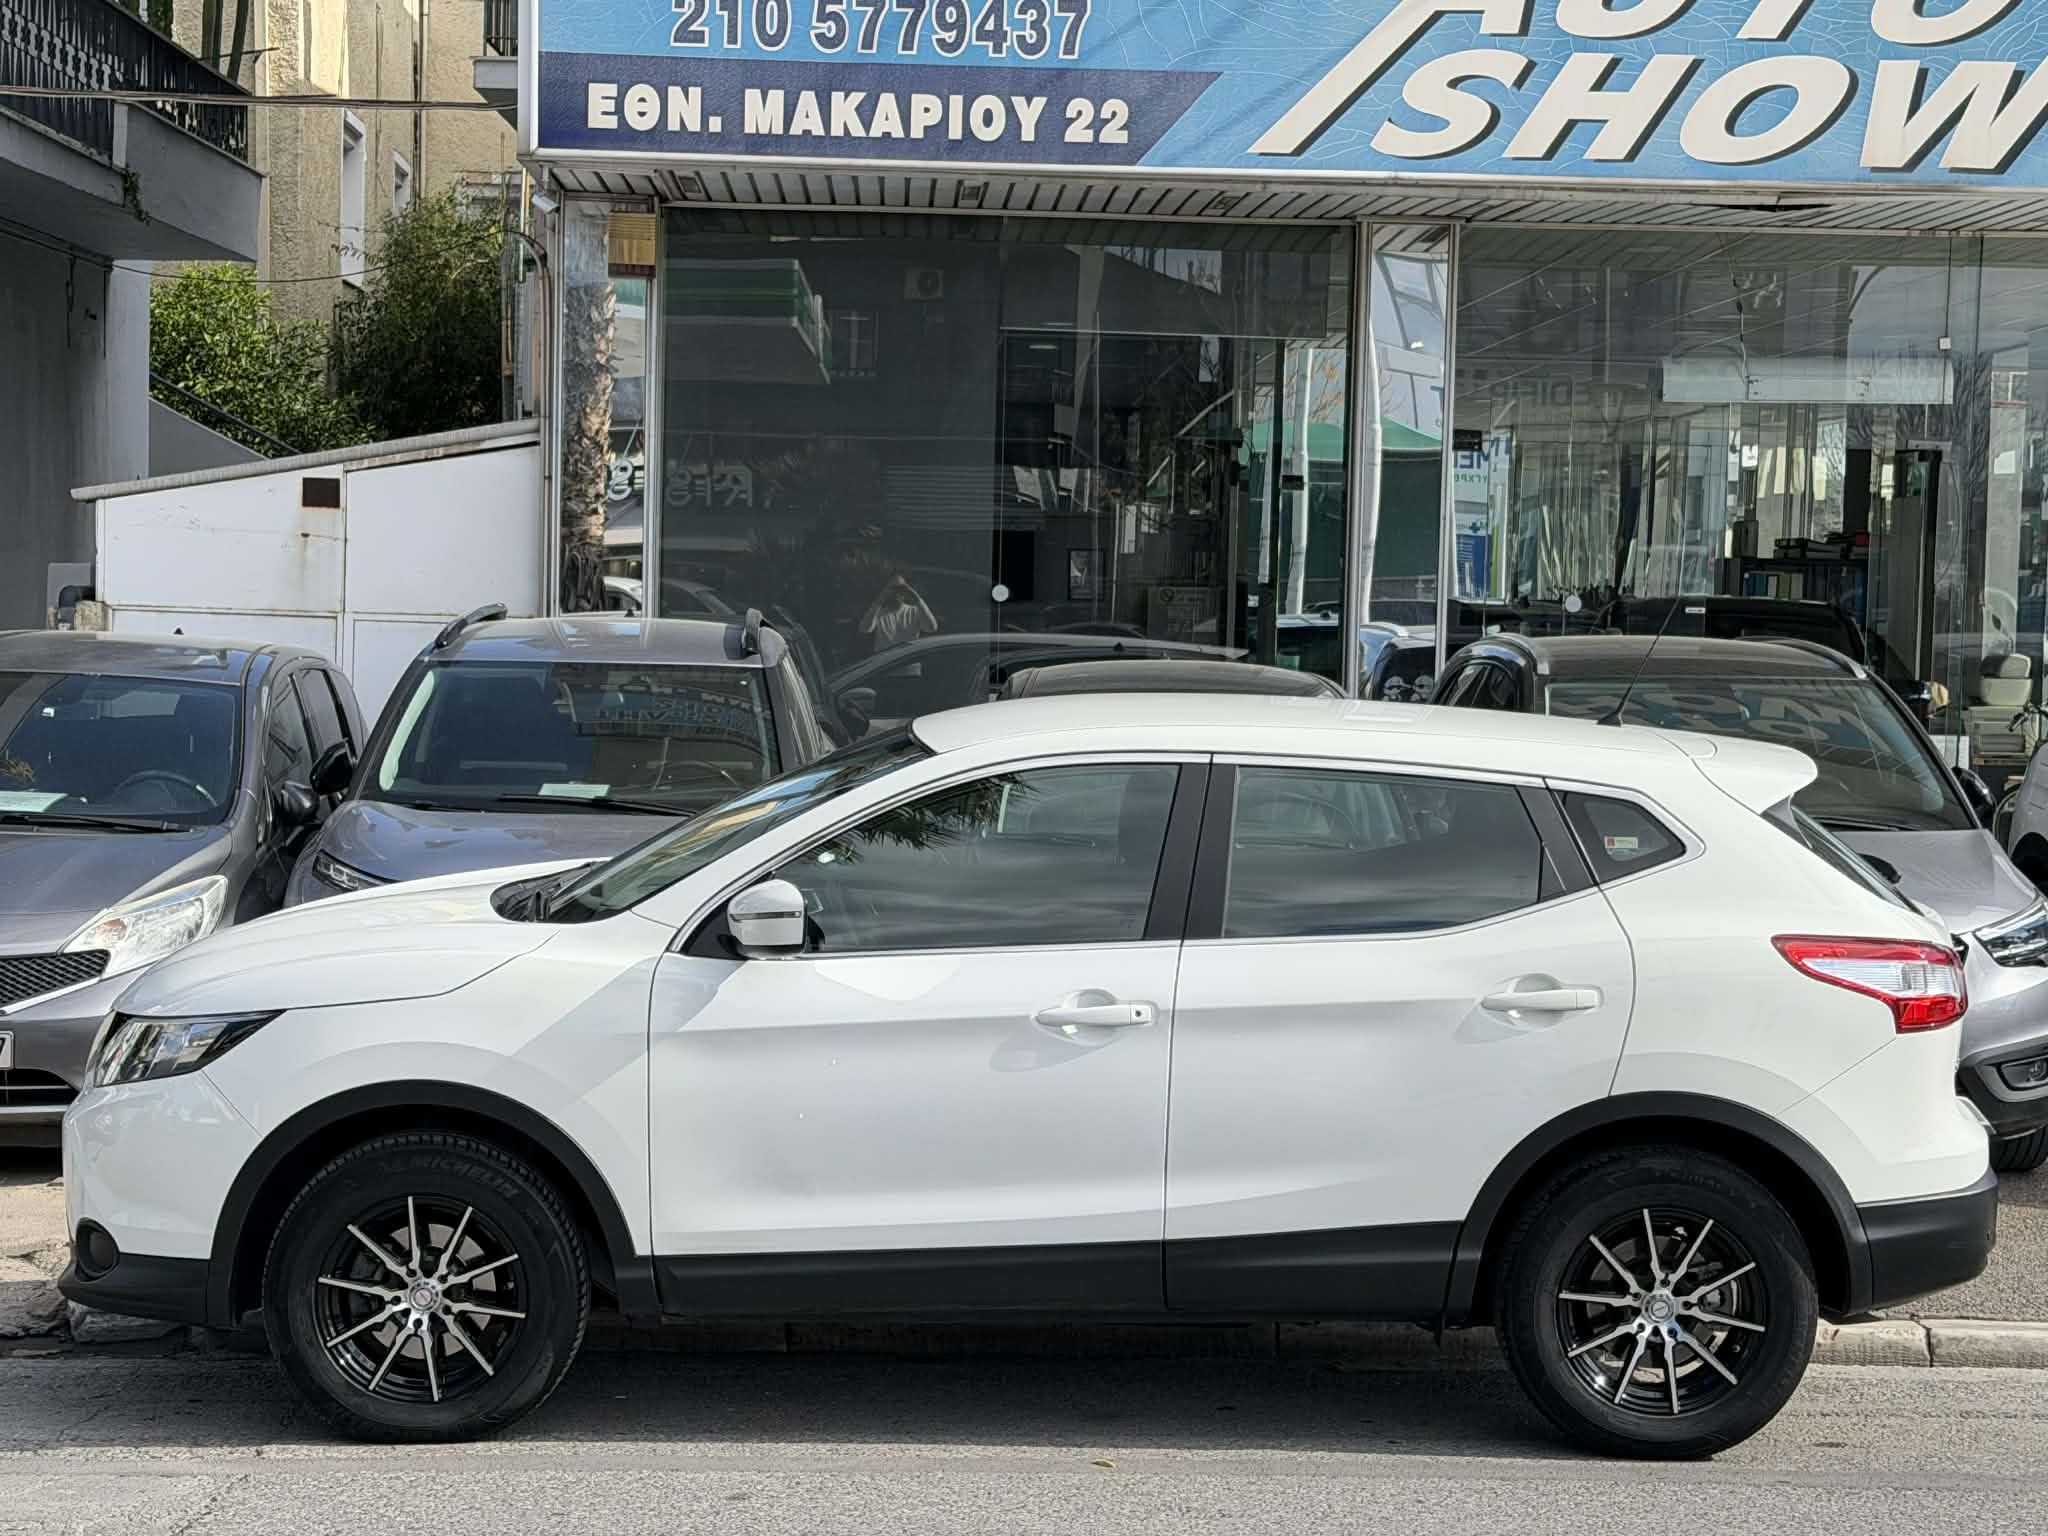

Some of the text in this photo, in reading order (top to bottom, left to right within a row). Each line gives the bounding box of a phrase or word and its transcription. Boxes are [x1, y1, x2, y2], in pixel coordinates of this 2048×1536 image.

[670, 0, 1091, 59] 210 5779437
[587, 82, 1129, 144] ΕΘΝ. ΜΑΚΑΡΙΟΥ 22
[1368, 47, 2048, 173] SHOW
